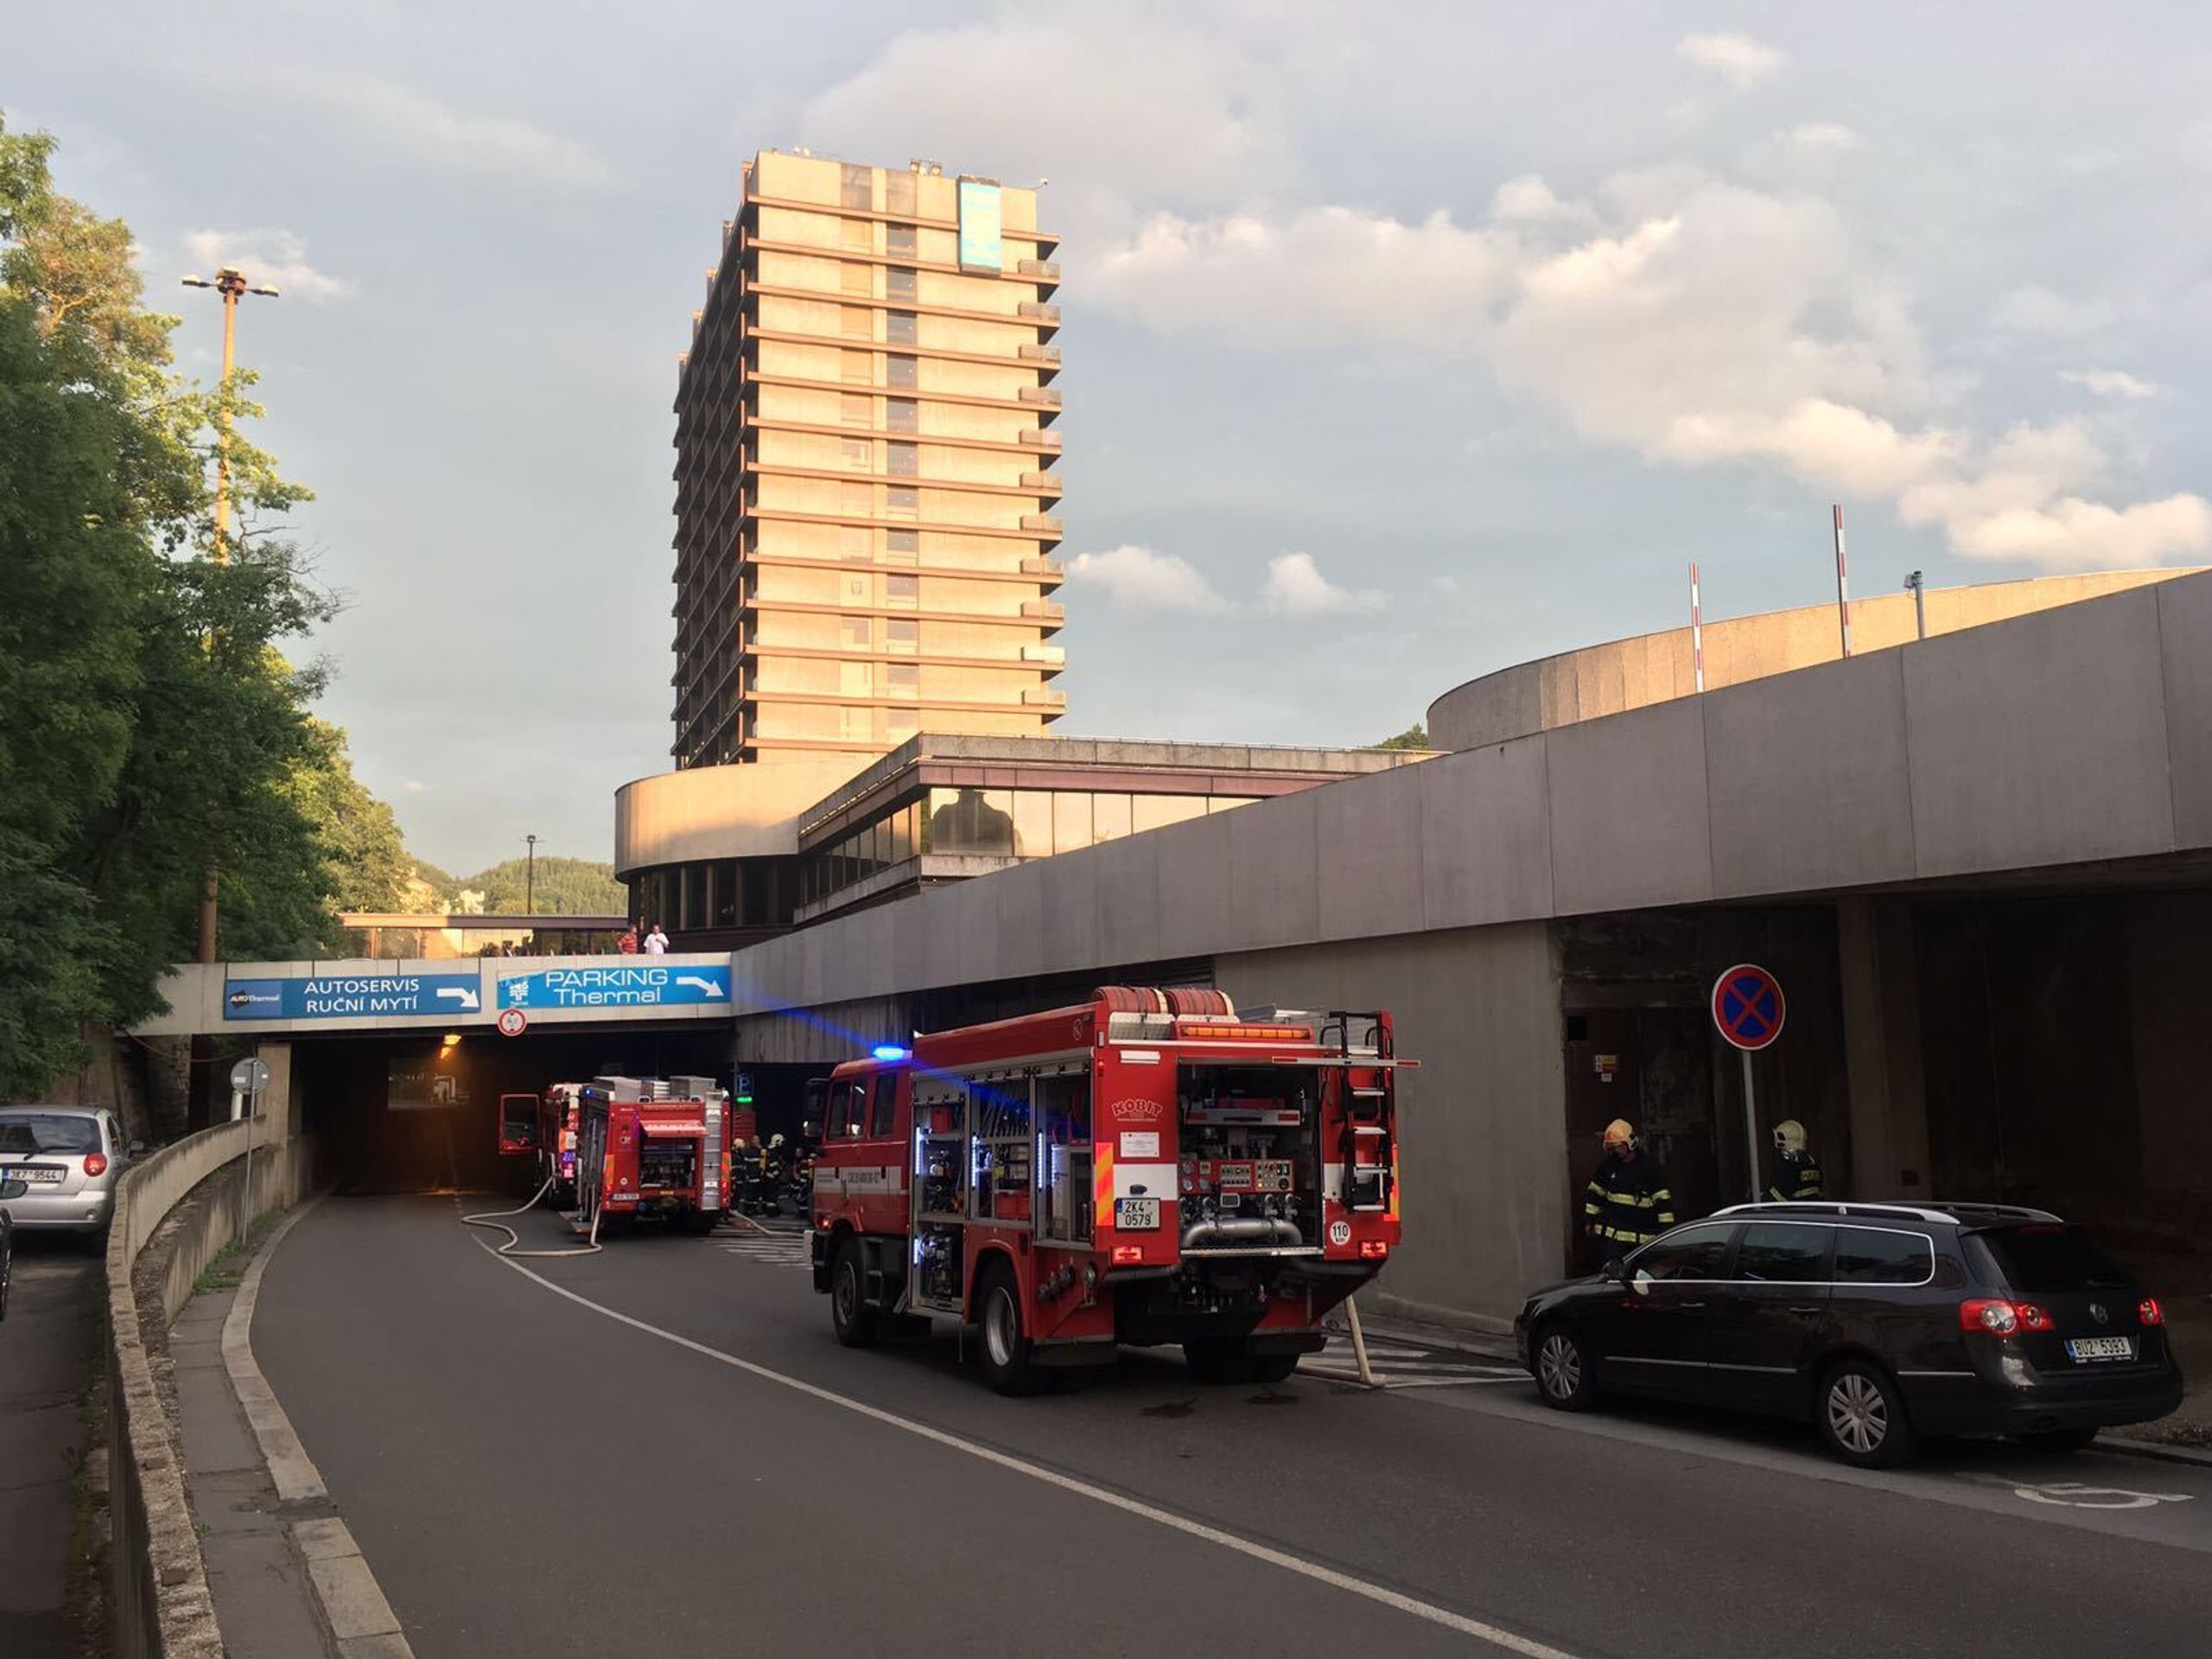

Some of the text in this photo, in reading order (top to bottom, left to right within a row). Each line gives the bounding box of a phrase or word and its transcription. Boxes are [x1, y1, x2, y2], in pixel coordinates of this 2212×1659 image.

[546, 969, 668, 988] PARKING
[304, 979, 420, 995] AUTOSERVIS
[553, 986, 660, 1005] Thermal
[306, 995, 417, 1013] RUČNÍ MYTÍ
[35, 1170, 57, 1180] 9544
[1125, 1201, 1145, 1213] 2K4
[1125, 1213, 1152, 1226] 0579
[1332, 1224, 1349, 1236] 110
[2075, 1338, 2126, 1356] 8U2 5393
